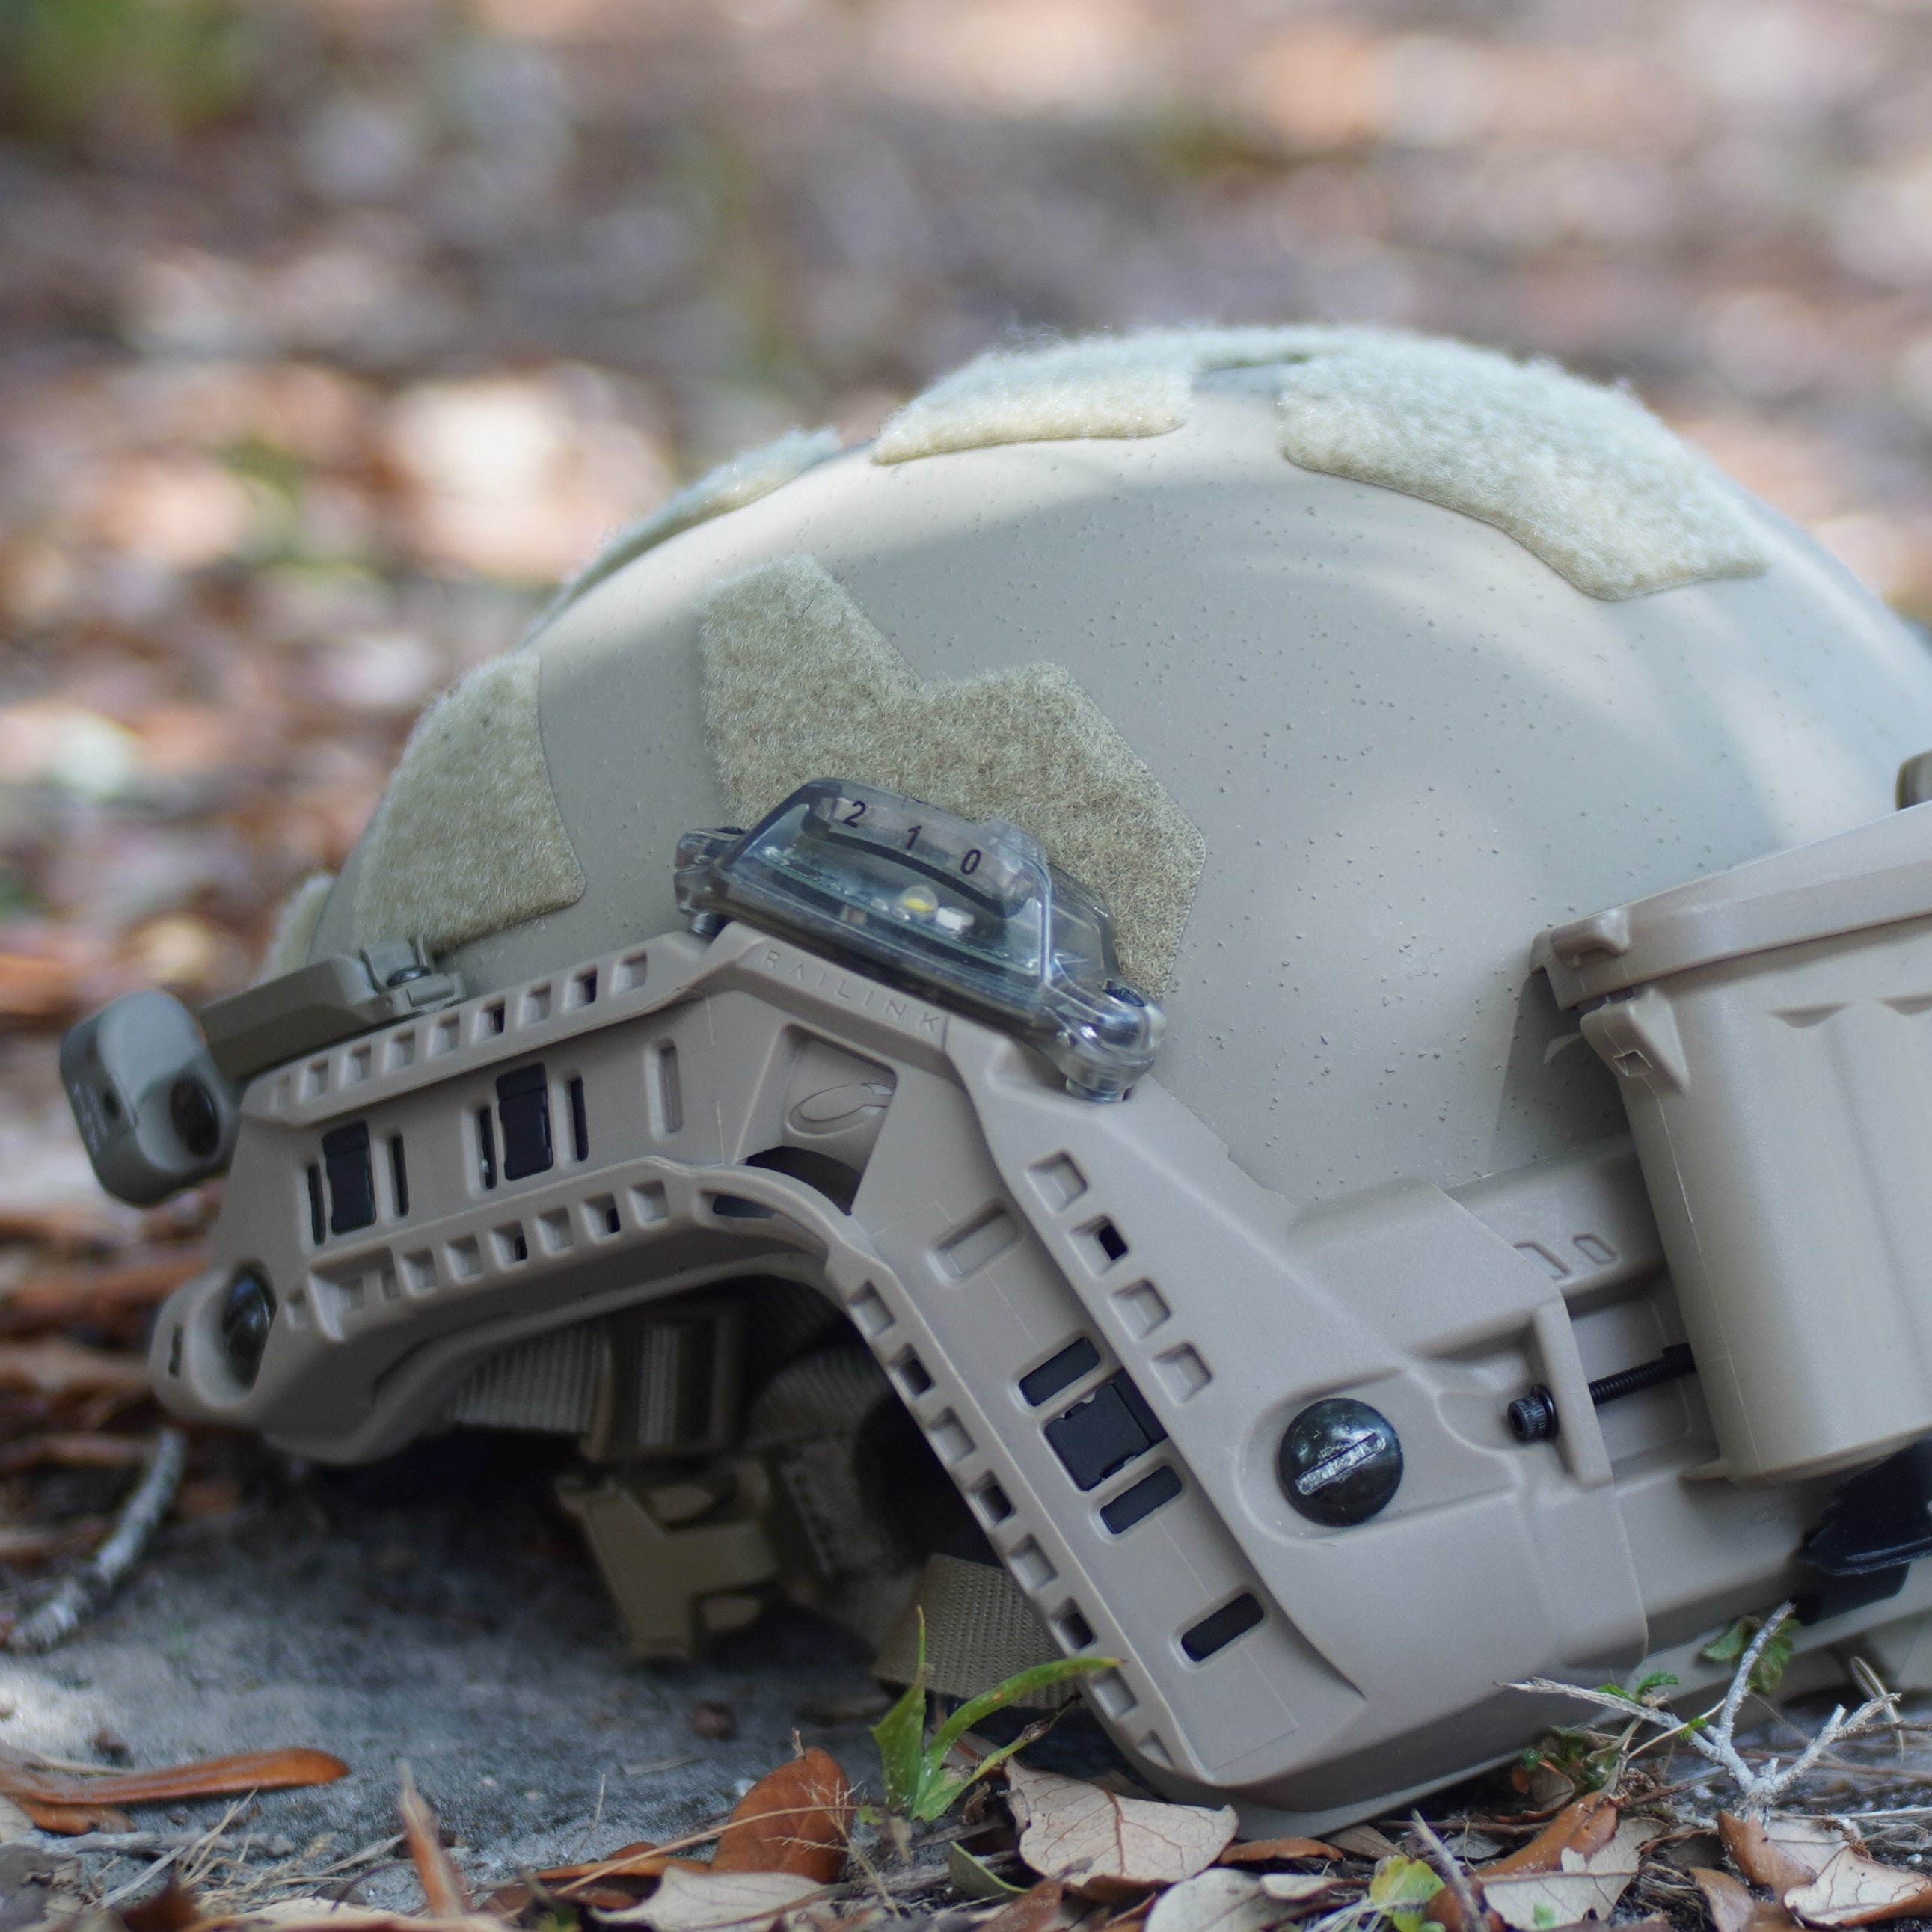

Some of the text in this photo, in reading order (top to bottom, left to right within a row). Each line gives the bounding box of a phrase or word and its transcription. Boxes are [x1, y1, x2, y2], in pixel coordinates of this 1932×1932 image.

[843, 800, 981, 876] 2 1 0
[764, 949, 941, 1032] RAILINK
